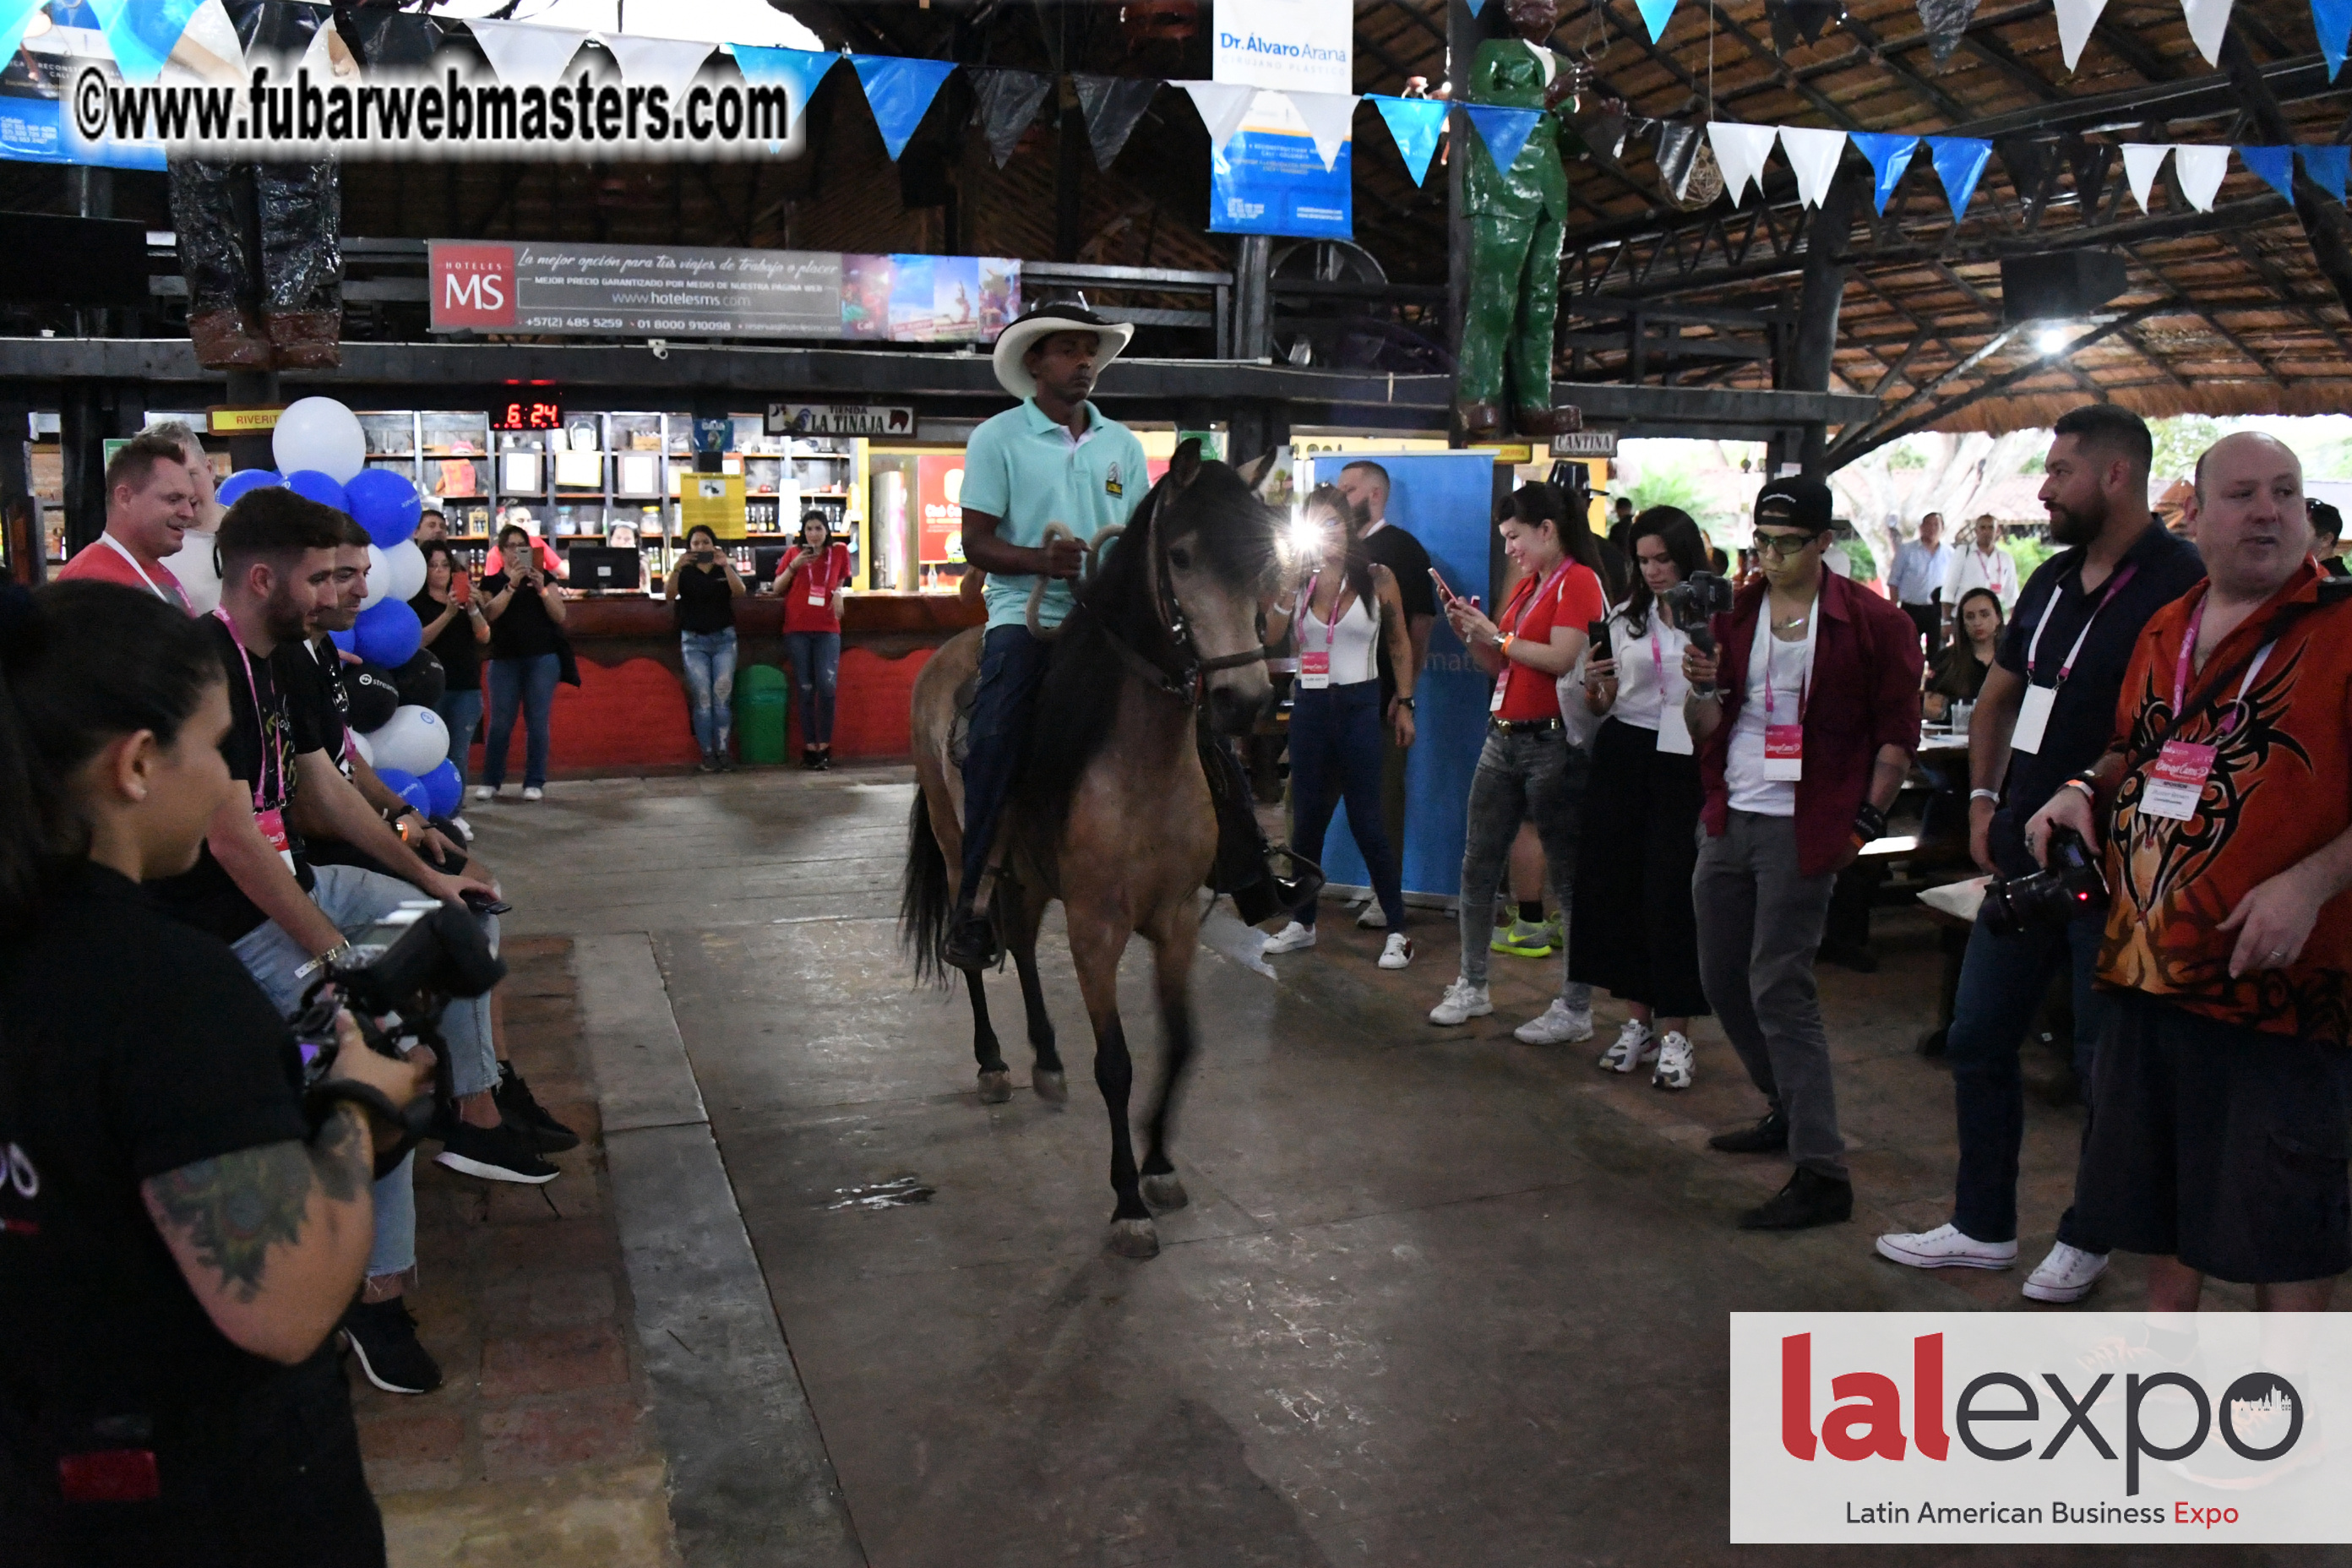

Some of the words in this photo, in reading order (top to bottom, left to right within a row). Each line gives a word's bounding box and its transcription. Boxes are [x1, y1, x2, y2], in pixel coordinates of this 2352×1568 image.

[1221, 33, 1244, 50] Dr.
[1247, 32, 1300, 57] Álvaro
[1301, 43, 1347, 63] Arana
[445, 261, 502, 270] HOTELES
[518, 248, 533, 266] La
[537, 253, 575, 271] mejor
[578, 255, 620, 272] opción
[620, 259, 653, 273] para
[679, 258, 716, 275] viajes
[719, 257, 735, 270] de
[738, 257, 784, 279] trabajo
[795, 259, 838, 280] placer
[535, 276, 564, 285] MEJOR
[567, 277, 600, 286] PRECIO
[602, 278, 663, 287] GARANTIZADO
[686, 280, 715, 289] MEDIO
[730, 282, 770, 291] NUESTRA
[445, 274, 504, 311] MS
[612, 291, 751, 307] www.hotelesms.com
[526, 317, 563, 328] +57(2)
[566, 317, 590, 327] 485
[593, 318, 623, 328] 5259
[637, 319, 651, 329] 01
[654, 320, 686, 329] 8000
[689, 321, 732, 330] 910098
[507, 403, 558, 424] 6:24
[830, 405, 868, 415] TIENDA
[237, 415, 278, 425] RIVERIT
[812, 414, 829, 433] LA
[833, 415, 885, 433] TINAJA
[1556, 435, 1614, 451] CANTINA
